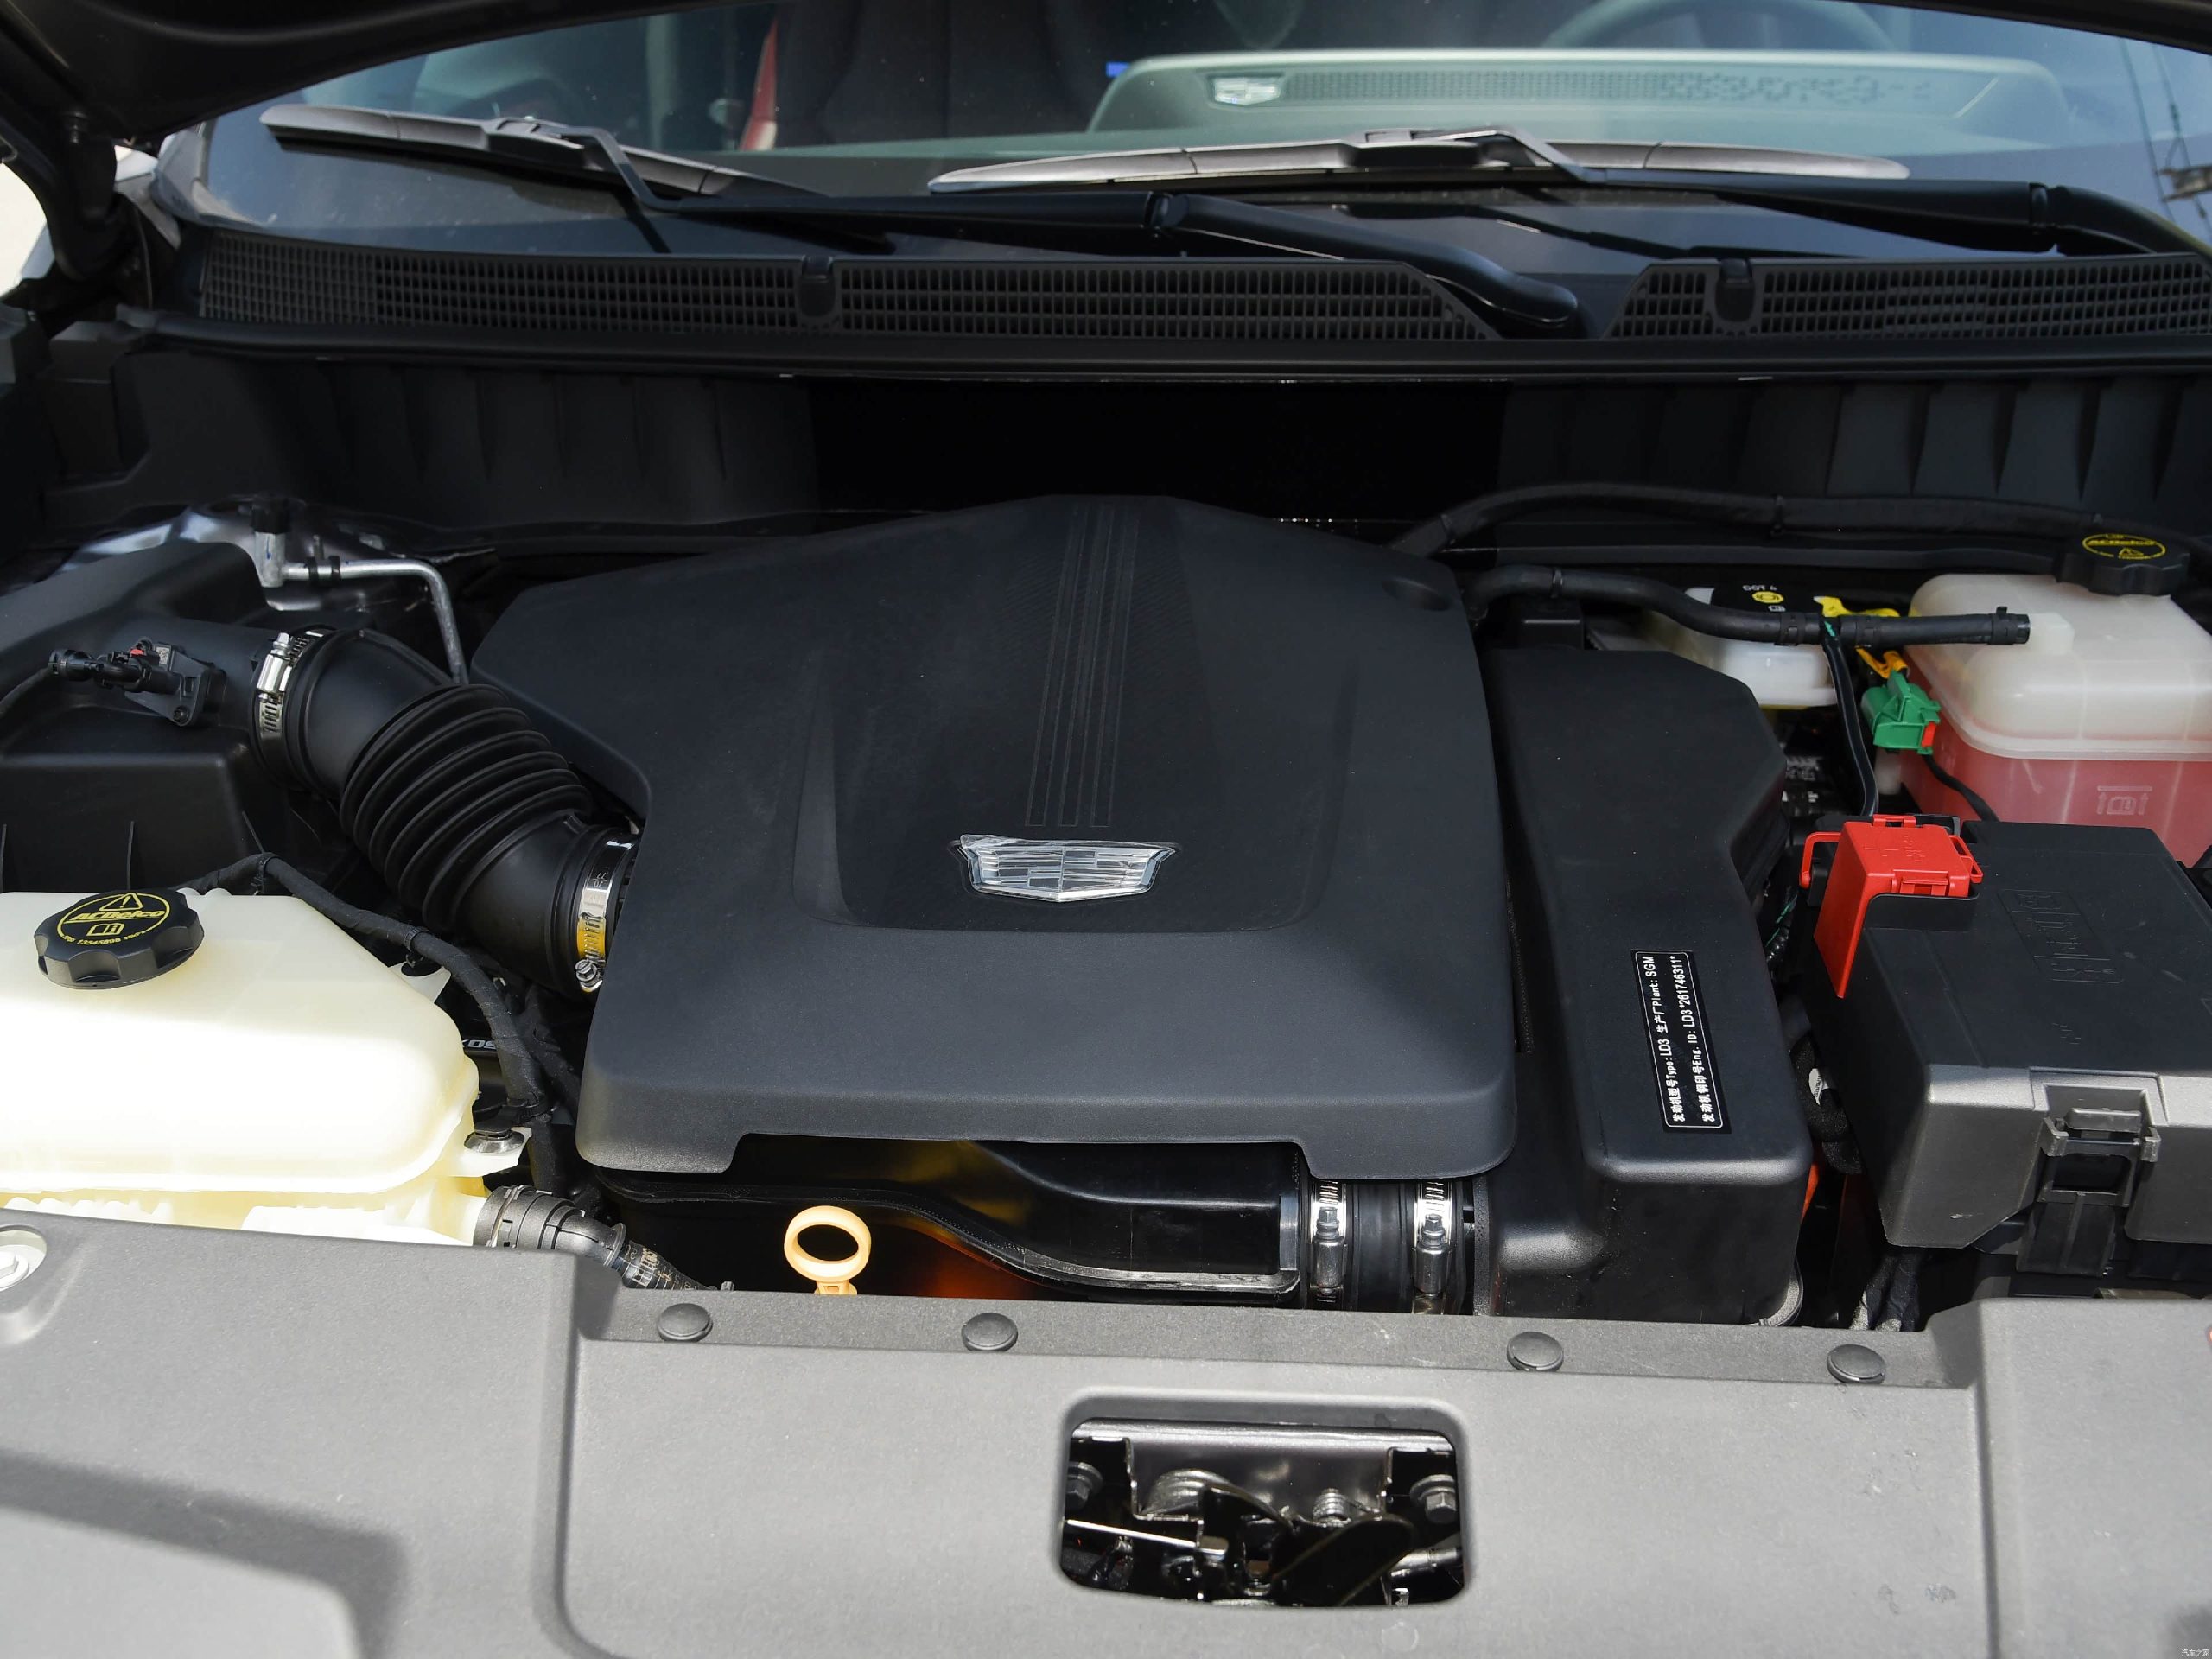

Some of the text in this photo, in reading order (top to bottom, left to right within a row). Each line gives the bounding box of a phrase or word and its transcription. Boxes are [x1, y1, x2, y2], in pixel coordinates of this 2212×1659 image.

[69, 910, 166, 922] ACDelco
[1643, 956, 1657, 977] SGM
[1658, 1039, 1672, 1056] LD3
